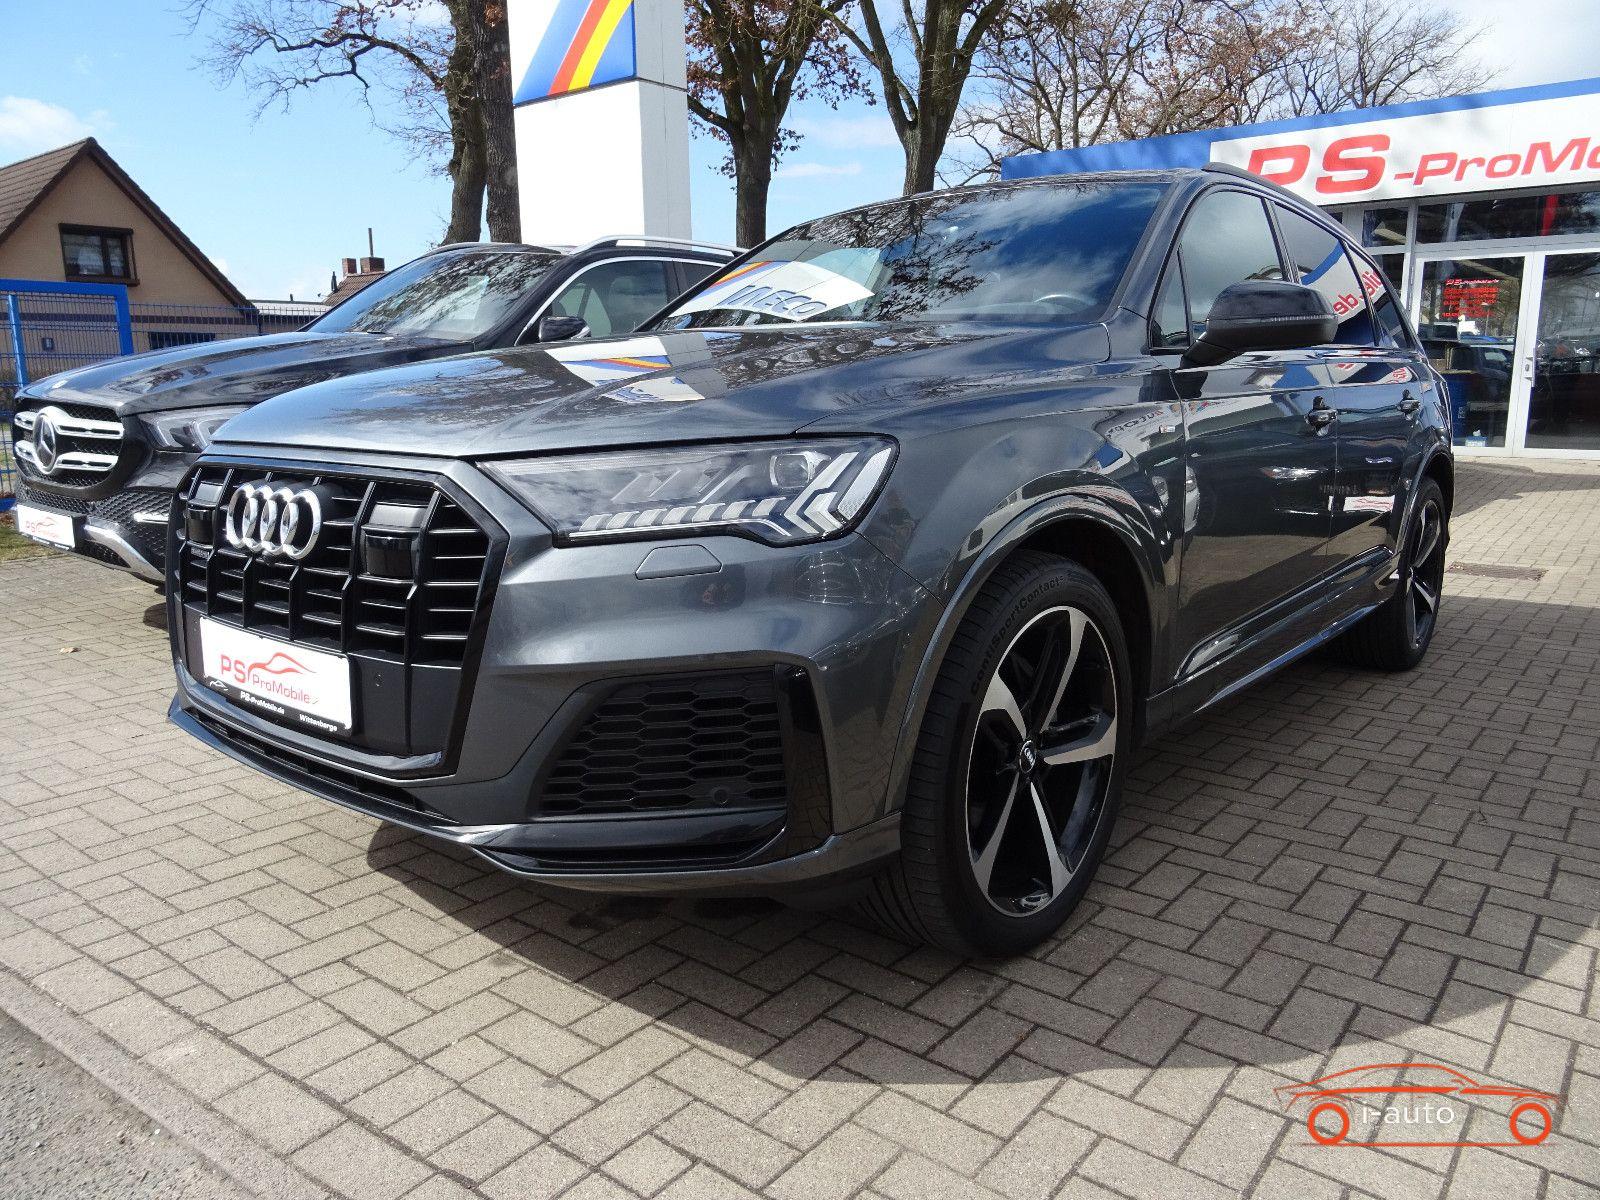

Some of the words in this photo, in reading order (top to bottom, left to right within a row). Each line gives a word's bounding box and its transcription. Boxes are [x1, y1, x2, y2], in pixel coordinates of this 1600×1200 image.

[1248, 134, 1600, 194] PS-ProM
[221, 654, 246, 683] PS
[252, 673, 310, 704] ProMobile
